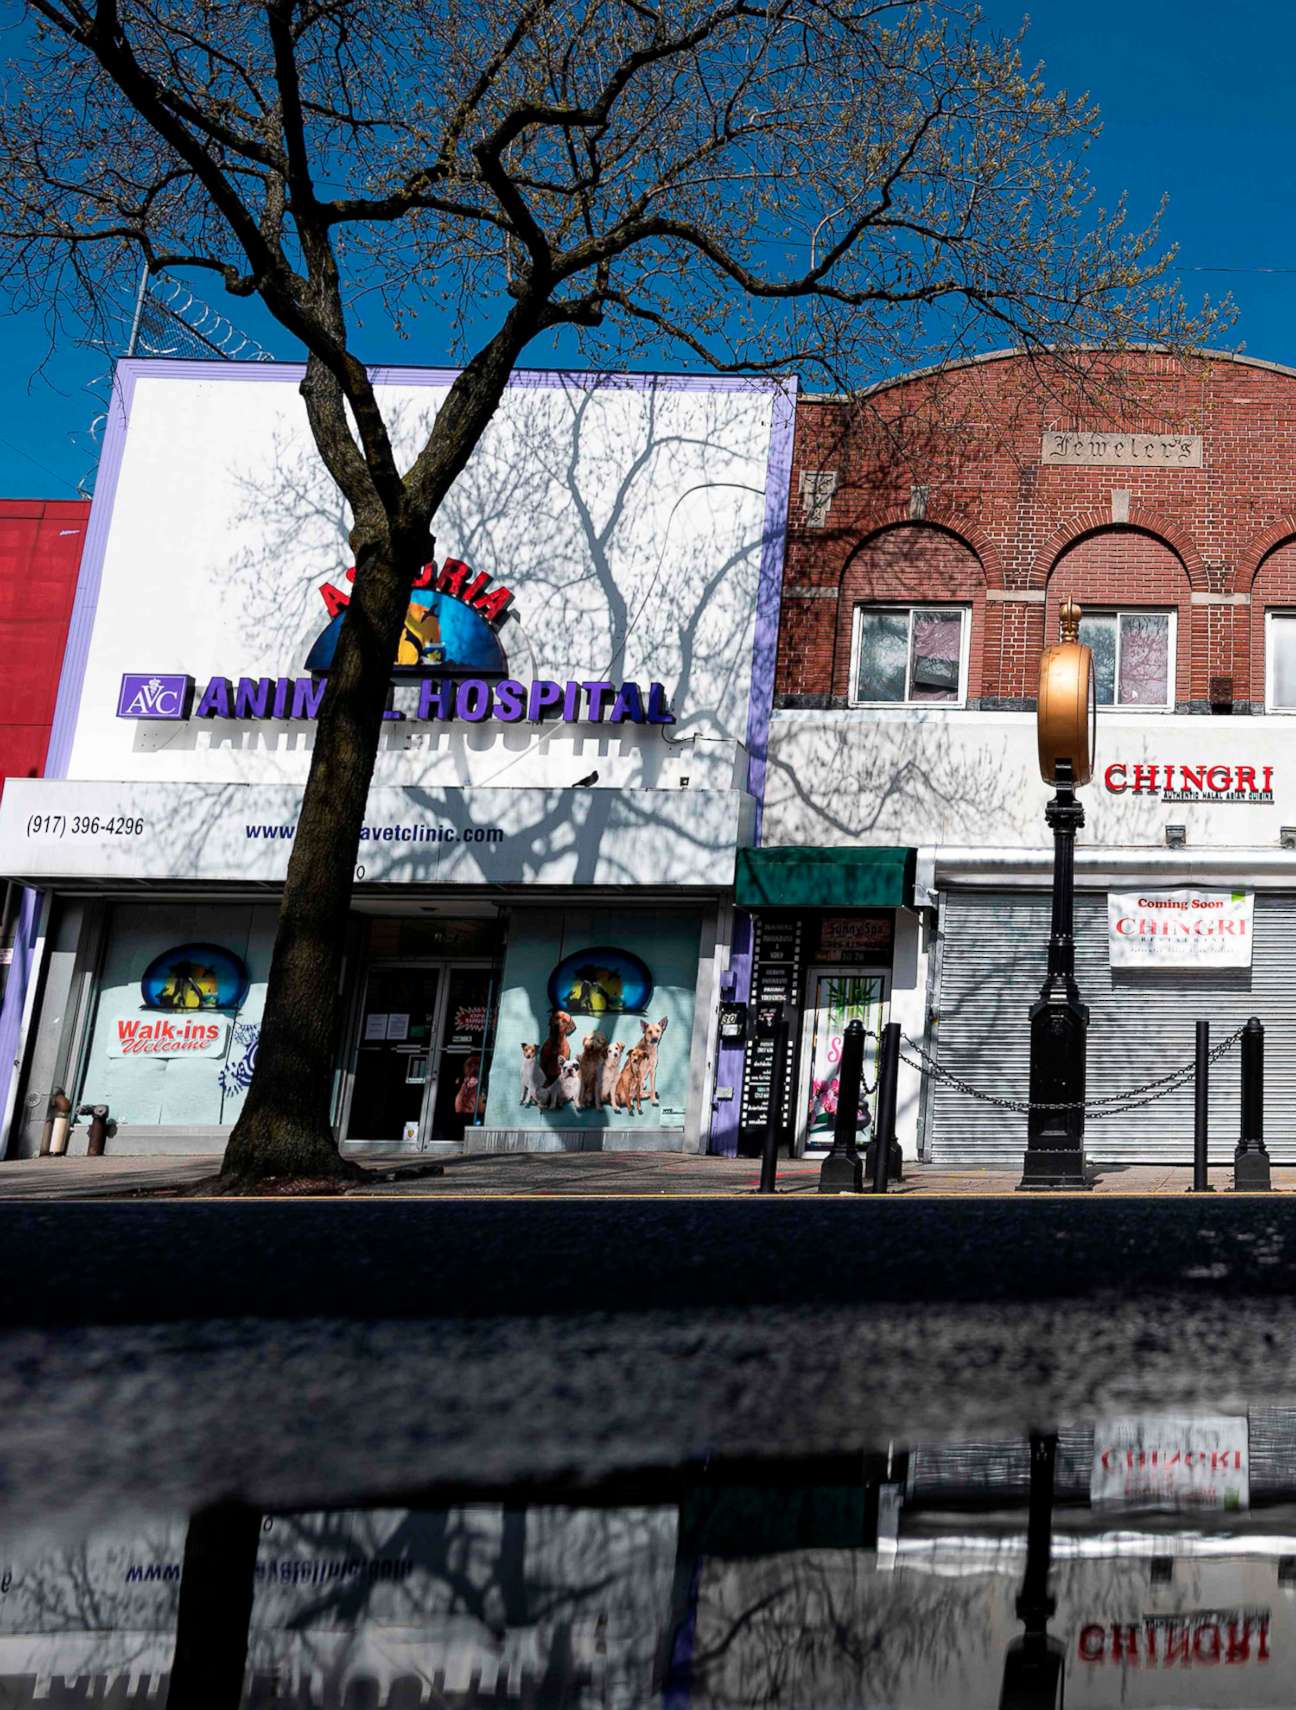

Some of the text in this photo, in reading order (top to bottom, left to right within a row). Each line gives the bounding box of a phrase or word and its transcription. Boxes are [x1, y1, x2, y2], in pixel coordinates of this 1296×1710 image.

[196, 676, 677, 724] ANIM HOSPITAL
[1104, 763, 1274, 795] CHINGRI
[1202, 791, 1223, 800] HALAL
[26, 815, 145, 838] (917) 396-4296
[1137, 898, 1224, 911] Coming Soon
[1115, 916, 1246, 936] CHINGRI
[117, 1020, 219, 1041] Walk-ins
[121, 1037, 212, 1054] Welcome
